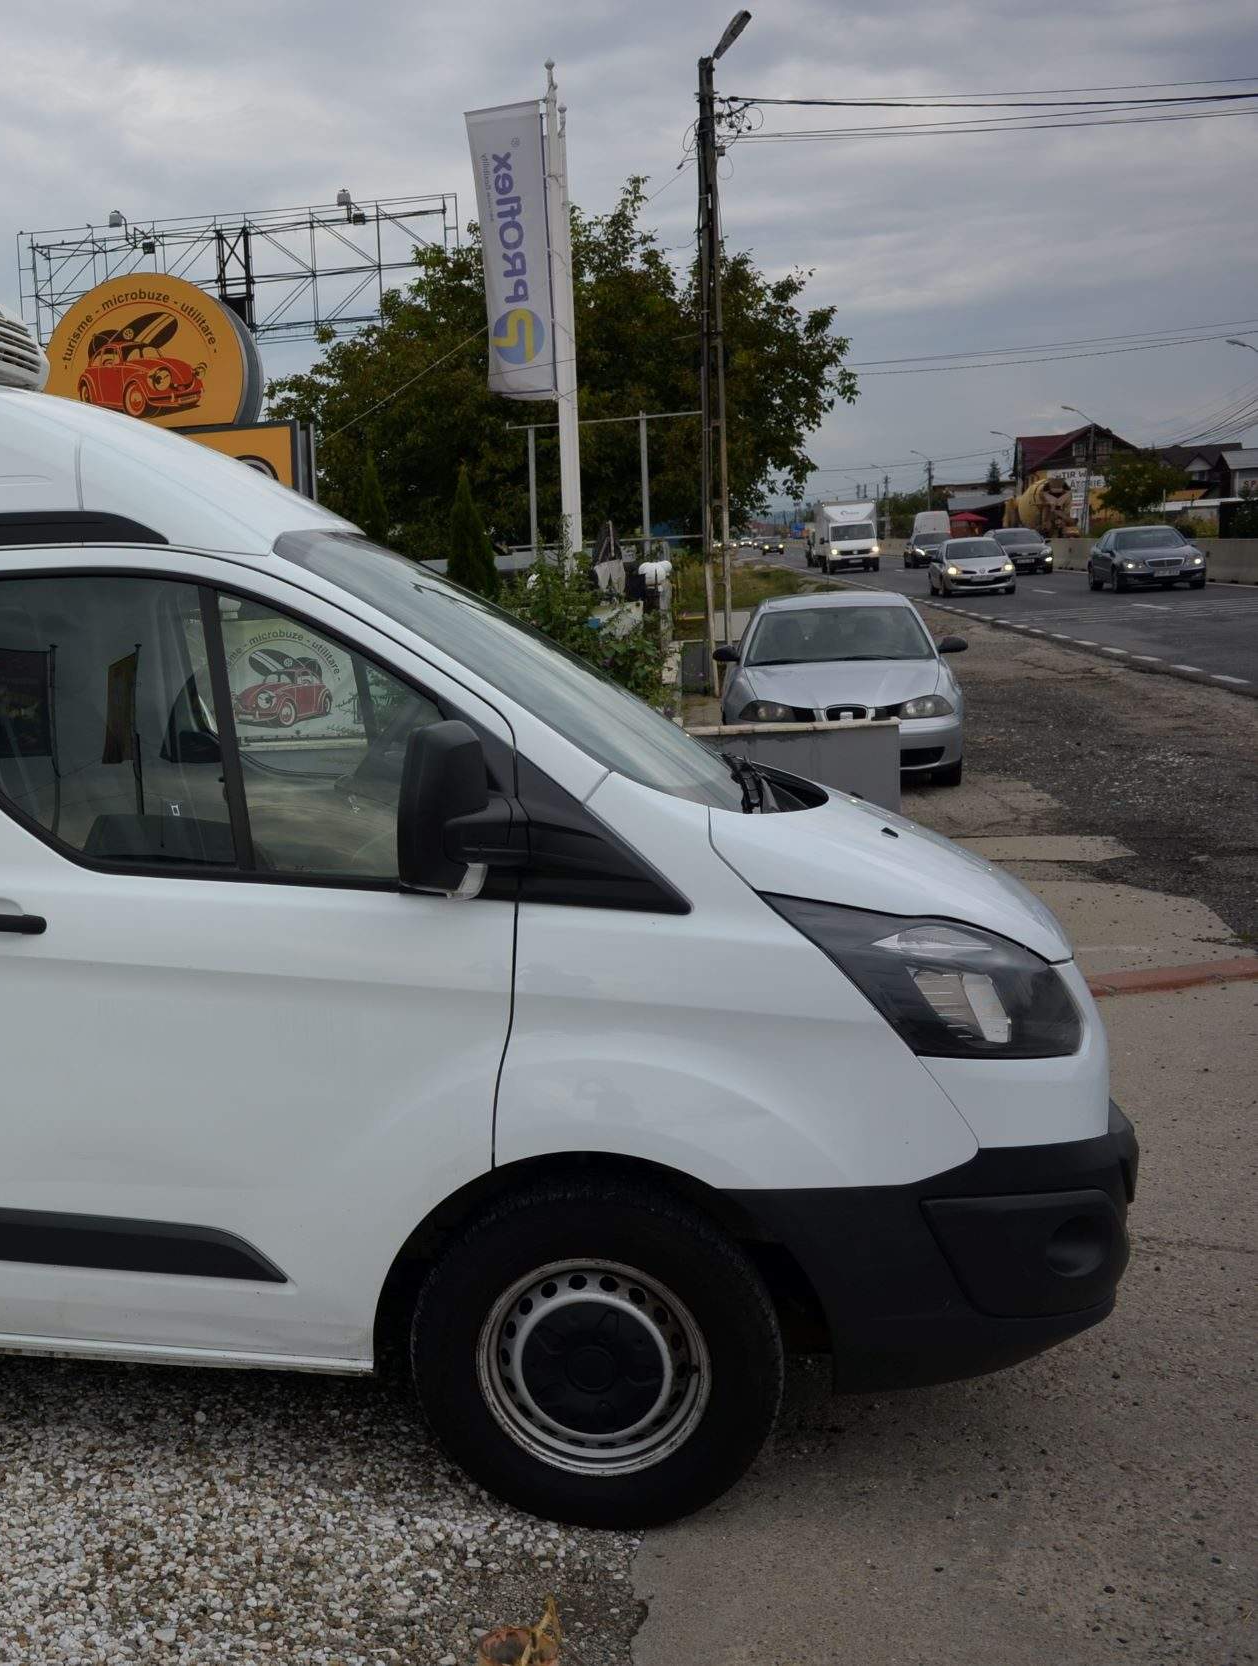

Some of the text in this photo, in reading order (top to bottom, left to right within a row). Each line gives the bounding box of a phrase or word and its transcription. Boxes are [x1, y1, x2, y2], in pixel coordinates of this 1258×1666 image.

[62, 314, 93, 362] turisme
[101, 288, 170, 311] microbuze
[181, 301, 217, 346] utilitare
[248, 629, 304, 646] microbuze
[312, 641, 340, 675] utilitare
